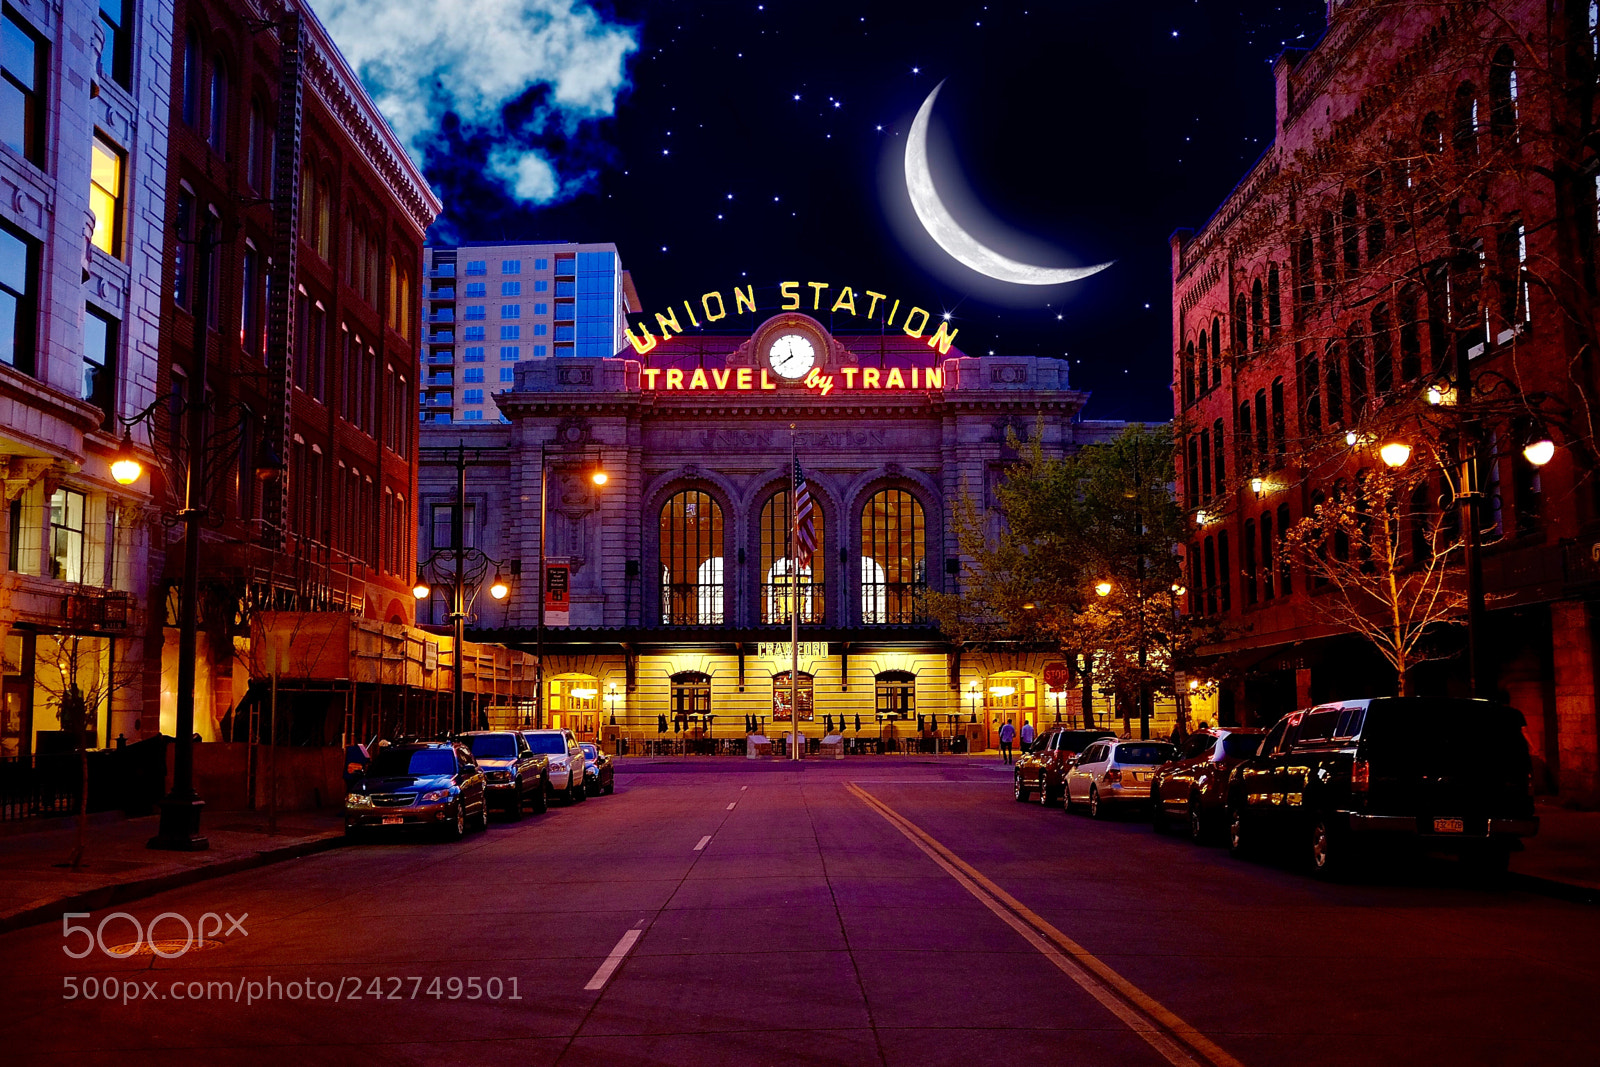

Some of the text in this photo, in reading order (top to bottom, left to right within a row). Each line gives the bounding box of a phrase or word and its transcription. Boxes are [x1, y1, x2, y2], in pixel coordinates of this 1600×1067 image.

[624, 281, 959, 355] UNION STATION
[642, 367, 942, 396] TRAVEL by TRAIN
[700, 431, 884, 446] UNION STATION
[1045, 670, 1067, 680] STOP
